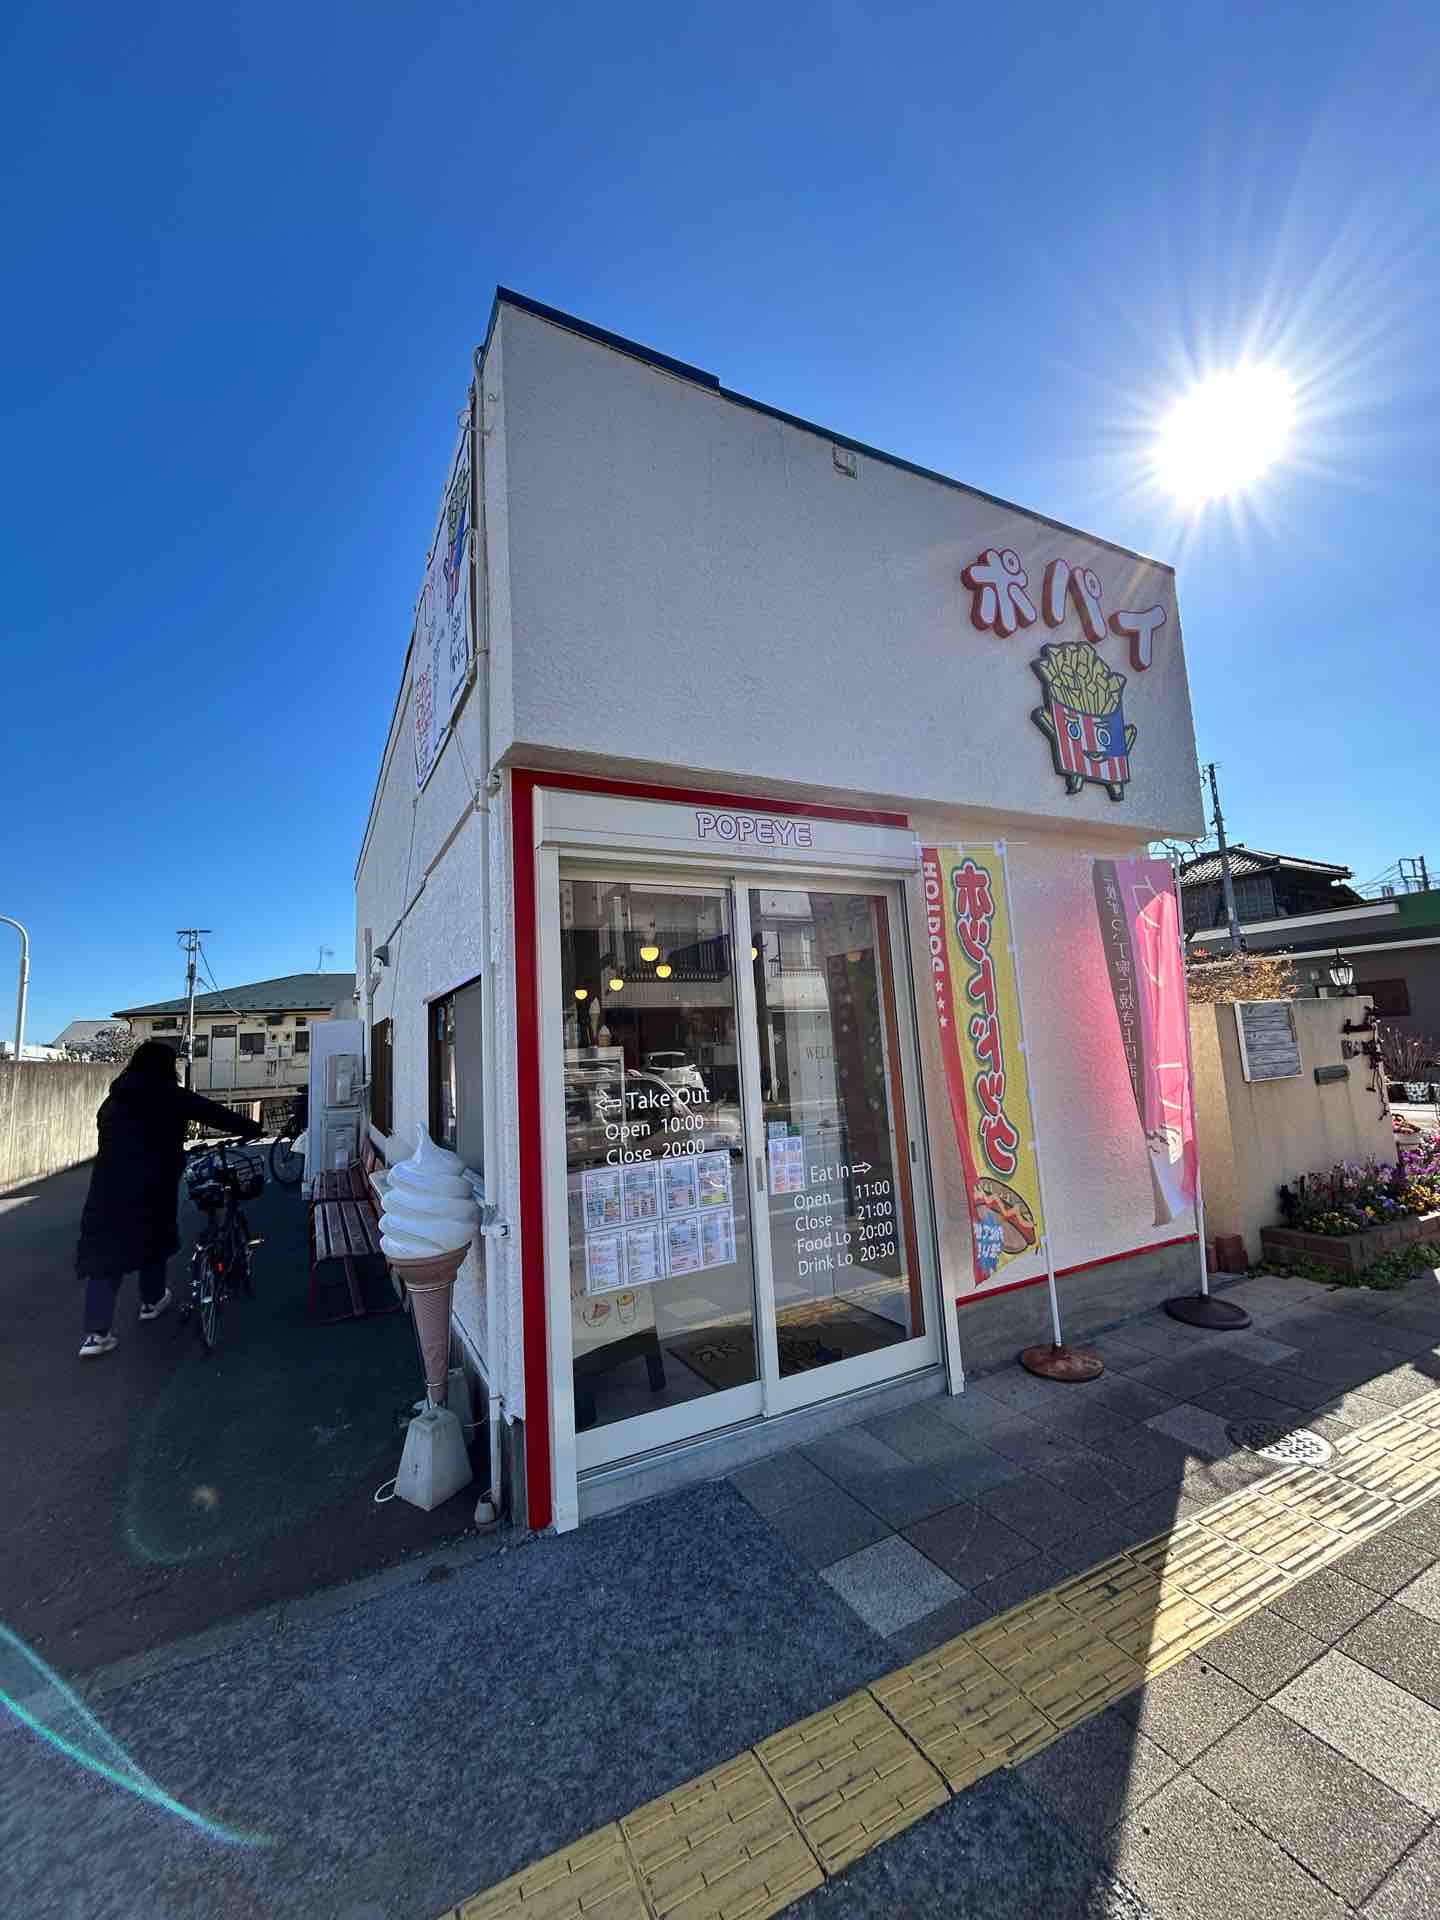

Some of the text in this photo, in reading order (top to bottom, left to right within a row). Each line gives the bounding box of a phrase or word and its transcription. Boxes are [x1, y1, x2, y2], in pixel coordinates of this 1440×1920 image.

[960, 548, 1168, 672] ポパイ
[696, 811, 813, 847] POPEYE
[626, 1087, 711, 1111] Take Out
[605, 1114, 704, 1141] Open 10:00
[606, 1139, 705, 1166] Close 20:00
[810, 1163, 849, 1184] Eat In
[794, 1180, 890, 1212] Open 11:00
[795, 1201, 893, 1232] Close 21:00
[797, 1221, 893, 1253] Food Lo 20:00
[798, 1241, 895, 1276] Drink Lo 20:30
